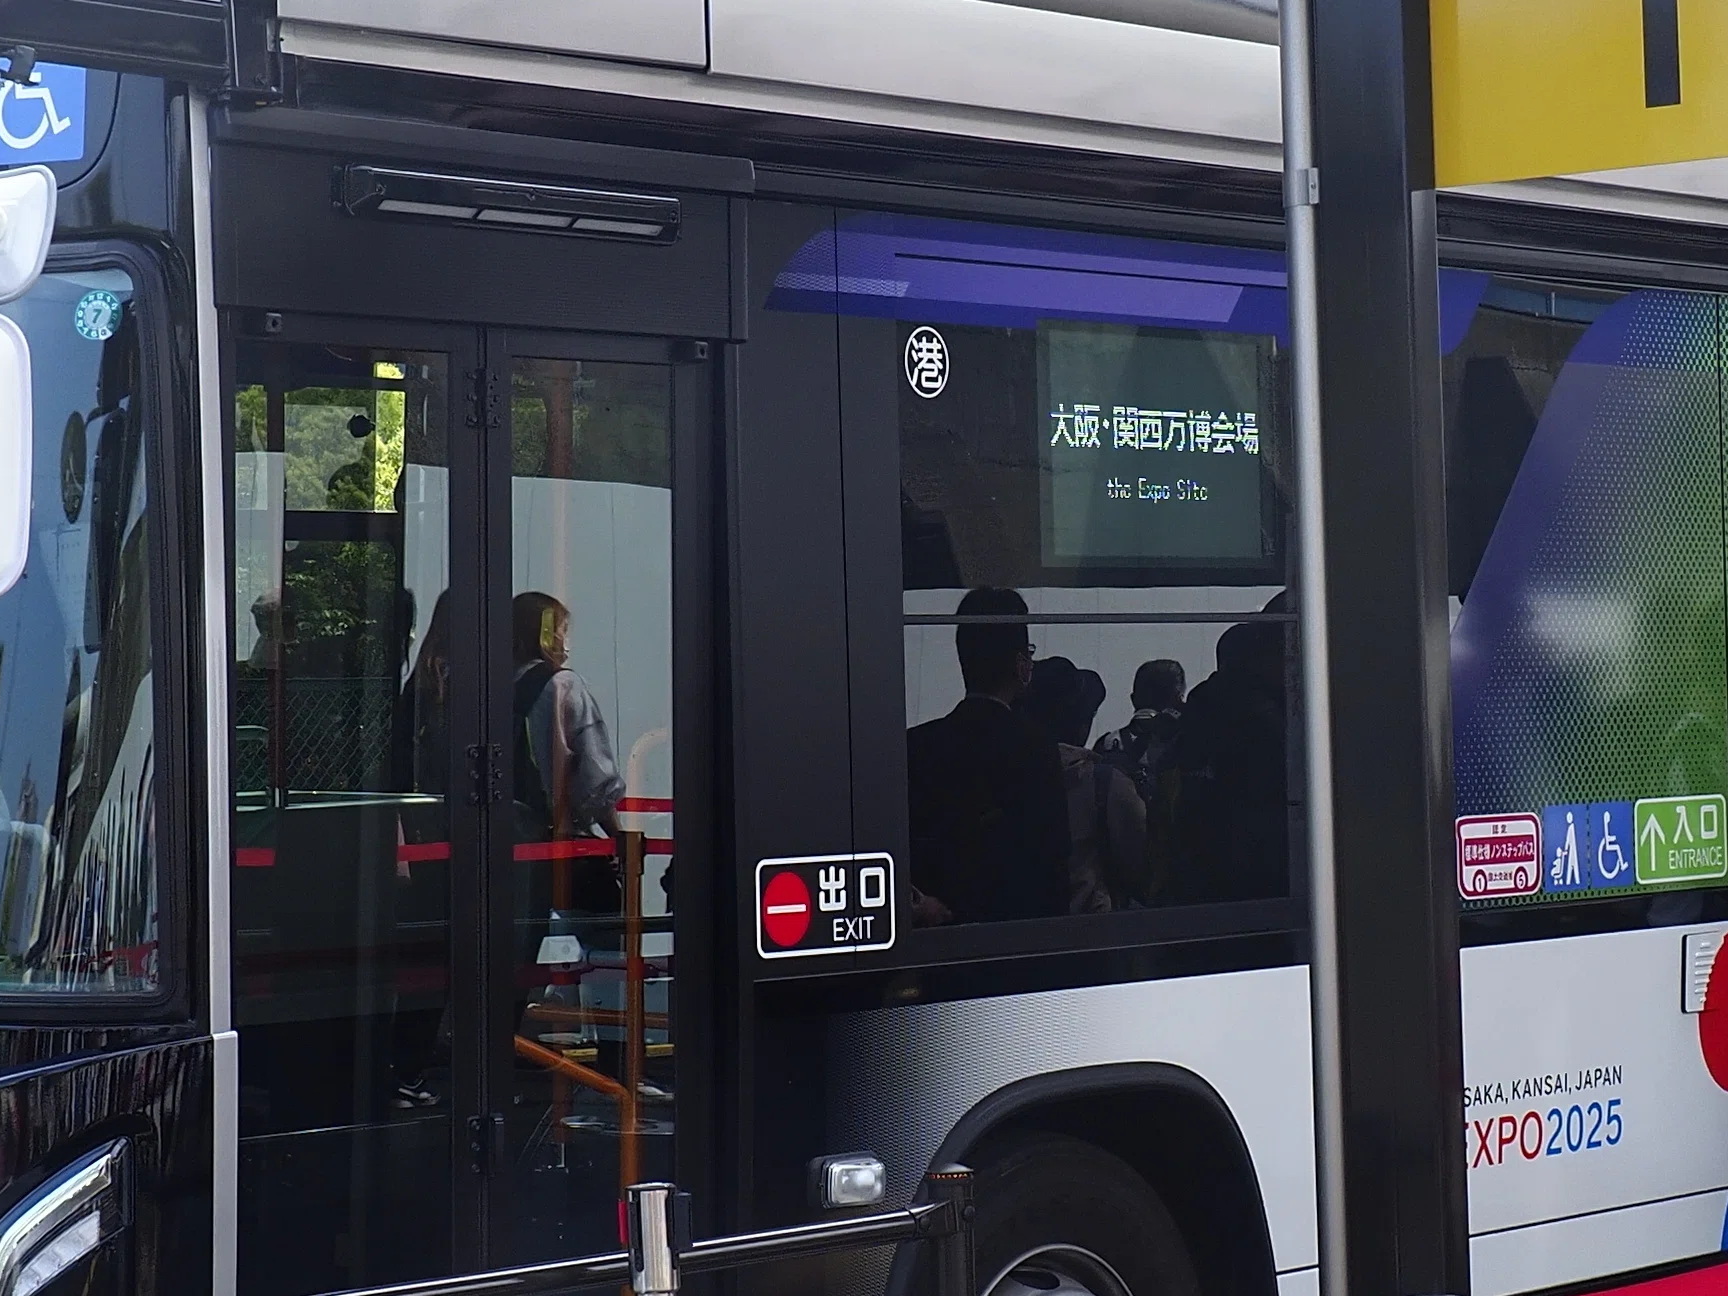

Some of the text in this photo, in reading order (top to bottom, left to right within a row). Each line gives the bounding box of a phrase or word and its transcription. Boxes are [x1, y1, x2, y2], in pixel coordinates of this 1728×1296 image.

[911, 336, 944, 389] 港
[1048, 403, 1259, 456] 大阪・関西万博会場
[1672, 804, 1718, 845] 入口
[1667, 846, 1724, 871] ENTRANCE
[818, 865, 886, 912] 出口
[832, 915, 875, 942] EXIT
[1462, 1064, 1623, 1108] SAKA, KANSAI, JAPAN
[1463, 1097, 1623, 1170] XPO2025
